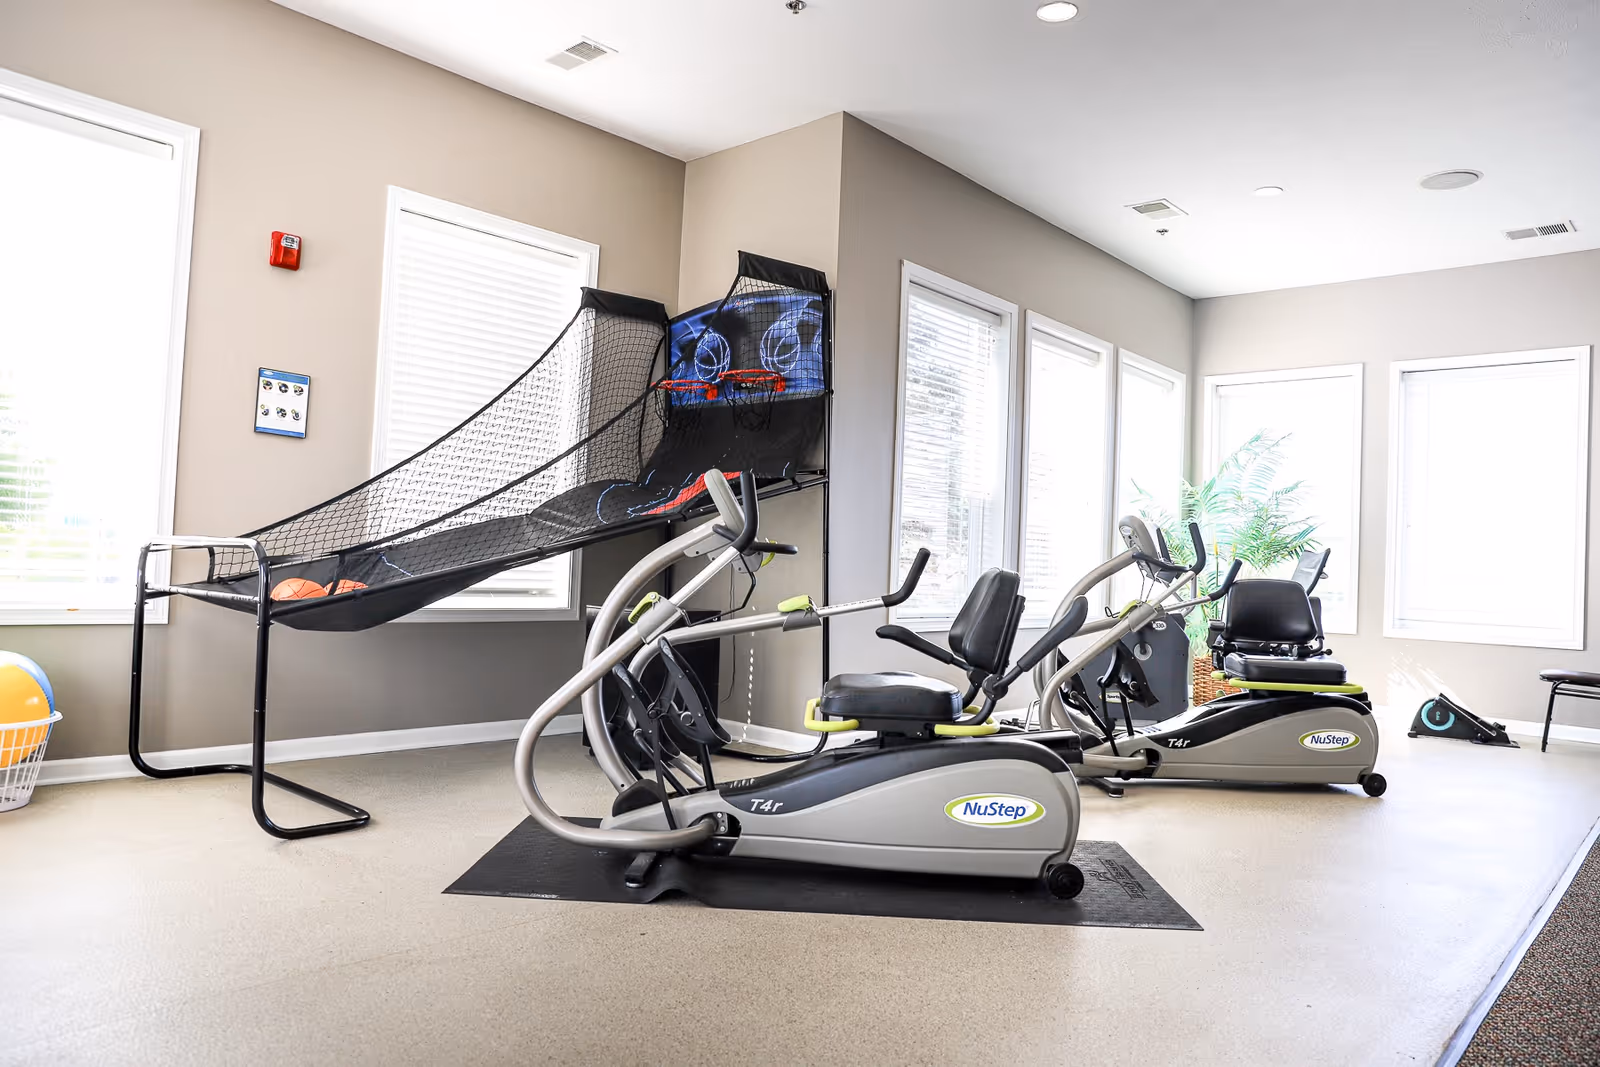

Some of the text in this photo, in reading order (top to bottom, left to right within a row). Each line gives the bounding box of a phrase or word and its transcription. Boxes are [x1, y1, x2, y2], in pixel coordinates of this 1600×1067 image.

[1168, 738, 1190, 747] T4r
[1310, 735, 1349, 746] NuStep
[750, 798, 784, 812] T4r
[963, 802, 1026, 819] NuStep
